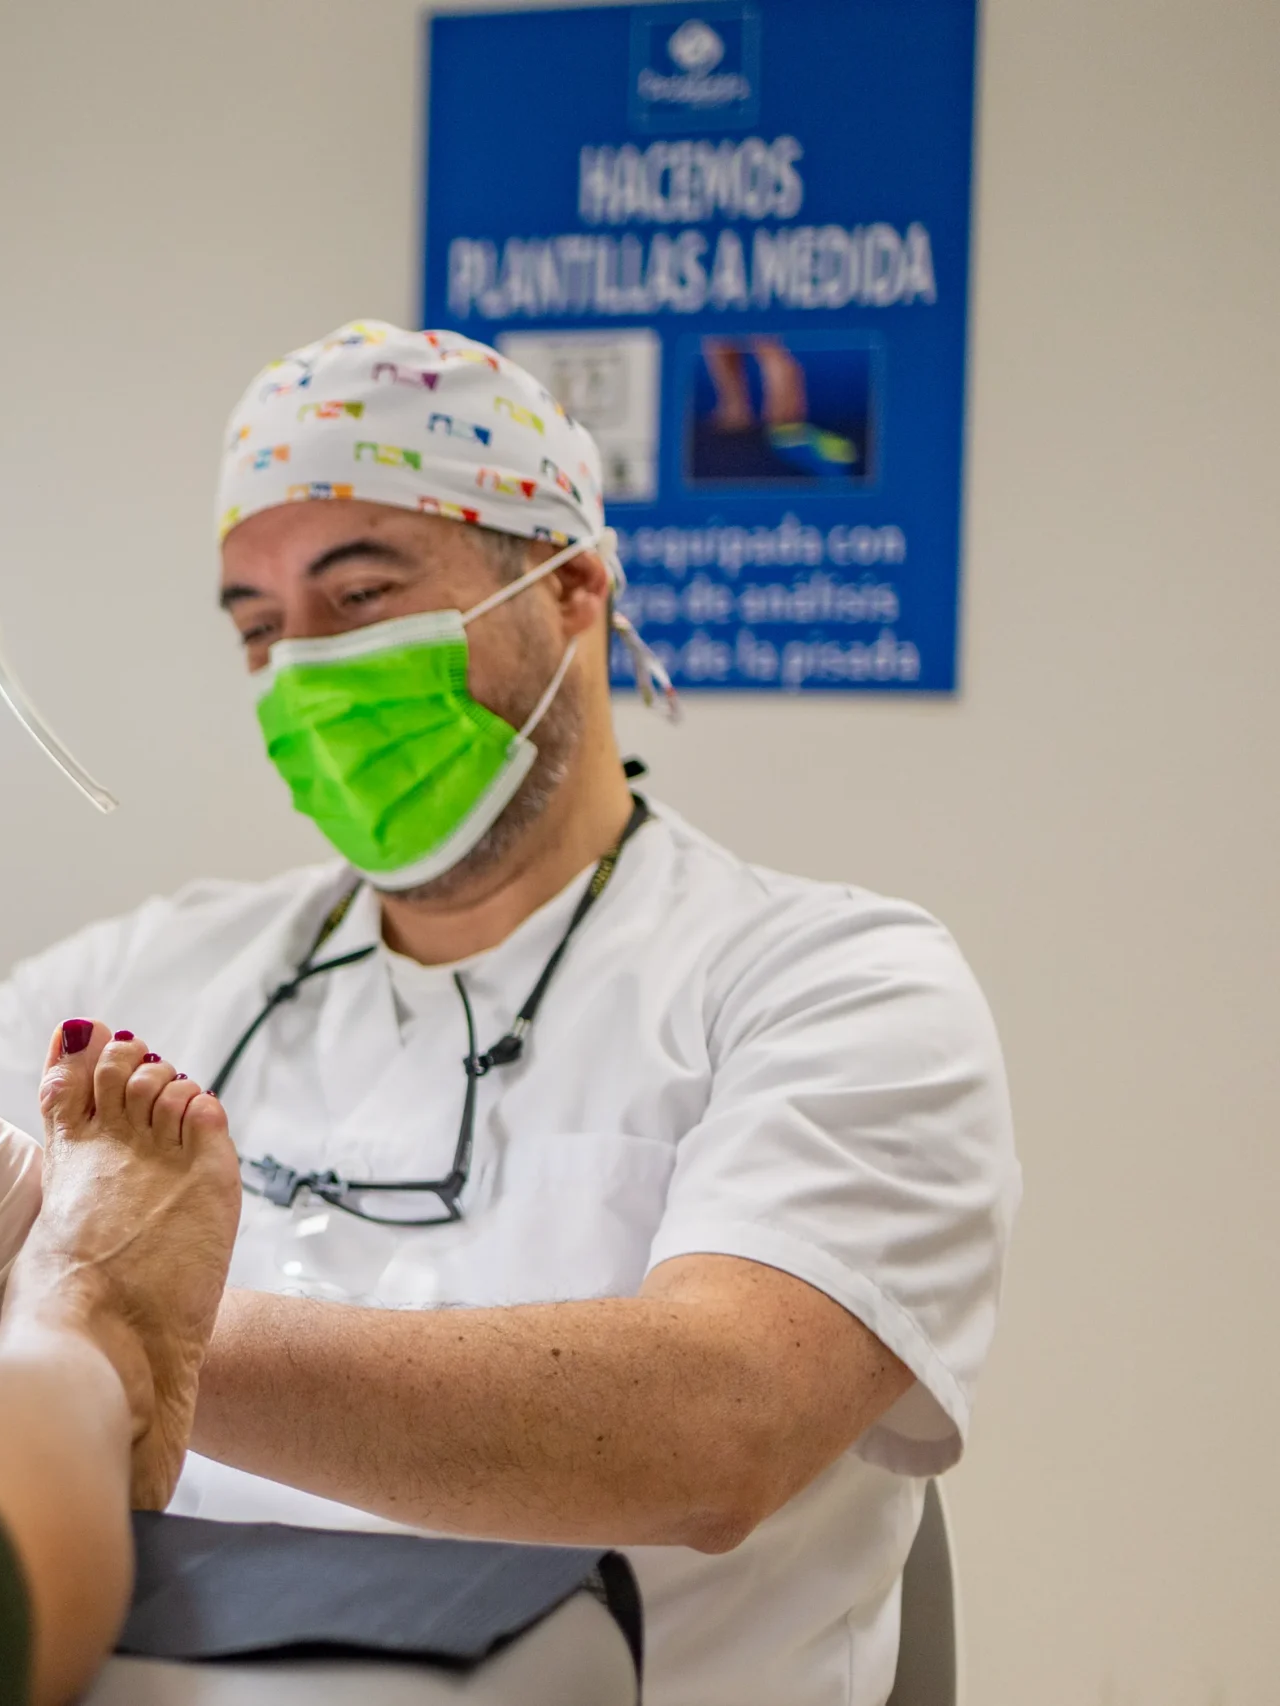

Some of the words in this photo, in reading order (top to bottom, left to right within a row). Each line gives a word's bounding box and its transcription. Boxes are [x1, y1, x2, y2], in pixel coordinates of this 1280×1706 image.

[581, 136, 803, 224] HACEMOS
[449, 231, 709, 316] PLANTILLAS
[711, 229, 749, 311] A
[752, 222, 935, 310] MEDIDA
[634, 513, 822, 576] equipada
[827, 525, 906, 565] con
[681, 574, 733, 624] de
[681, 629, 733, 681] de
[736, 628, 778, 681] la
[782, 628, 920, 692] pisada
